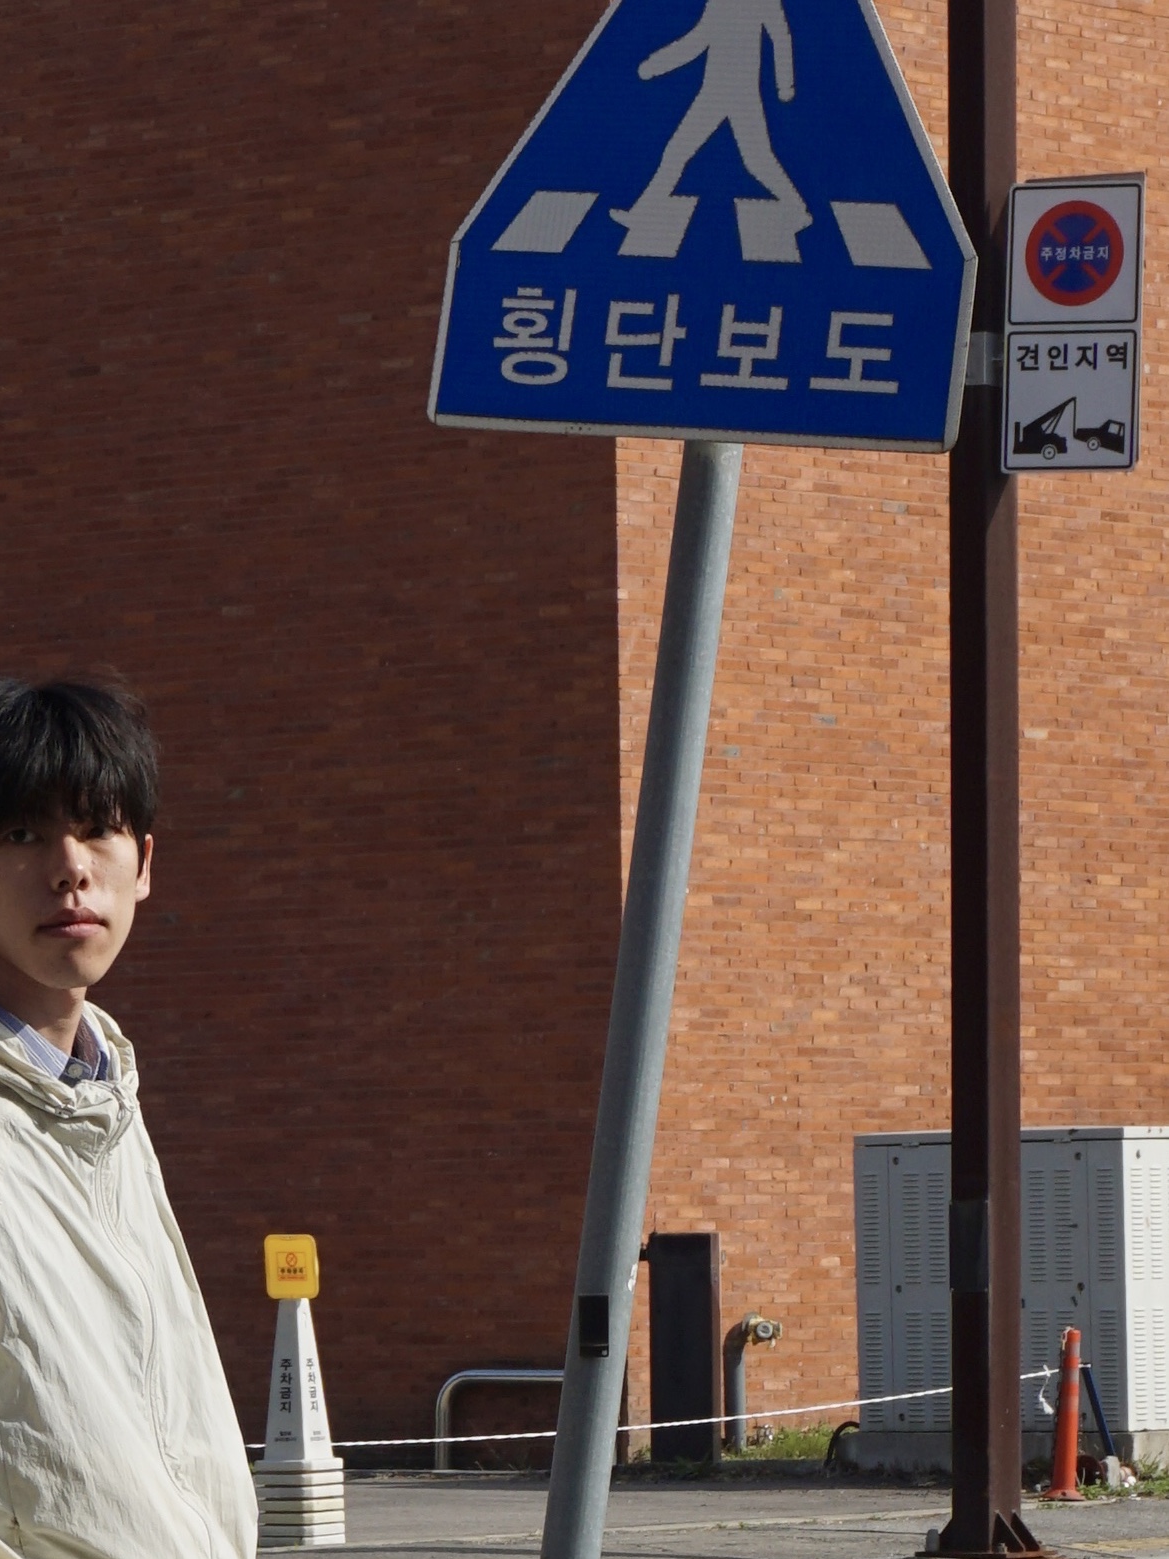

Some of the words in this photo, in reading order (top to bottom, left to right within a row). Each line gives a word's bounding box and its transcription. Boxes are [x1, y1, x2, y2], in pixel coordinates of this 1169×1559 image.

[1040, 244, 1109, 262] 주정차금지
[492, 286, 900, 395] 횡단보도
[1016, 341, 1129, 372] 견인지역
[279, 1358, 293, 1413] 주차금지
[305, 1358, 319, 1413] 주차금지
